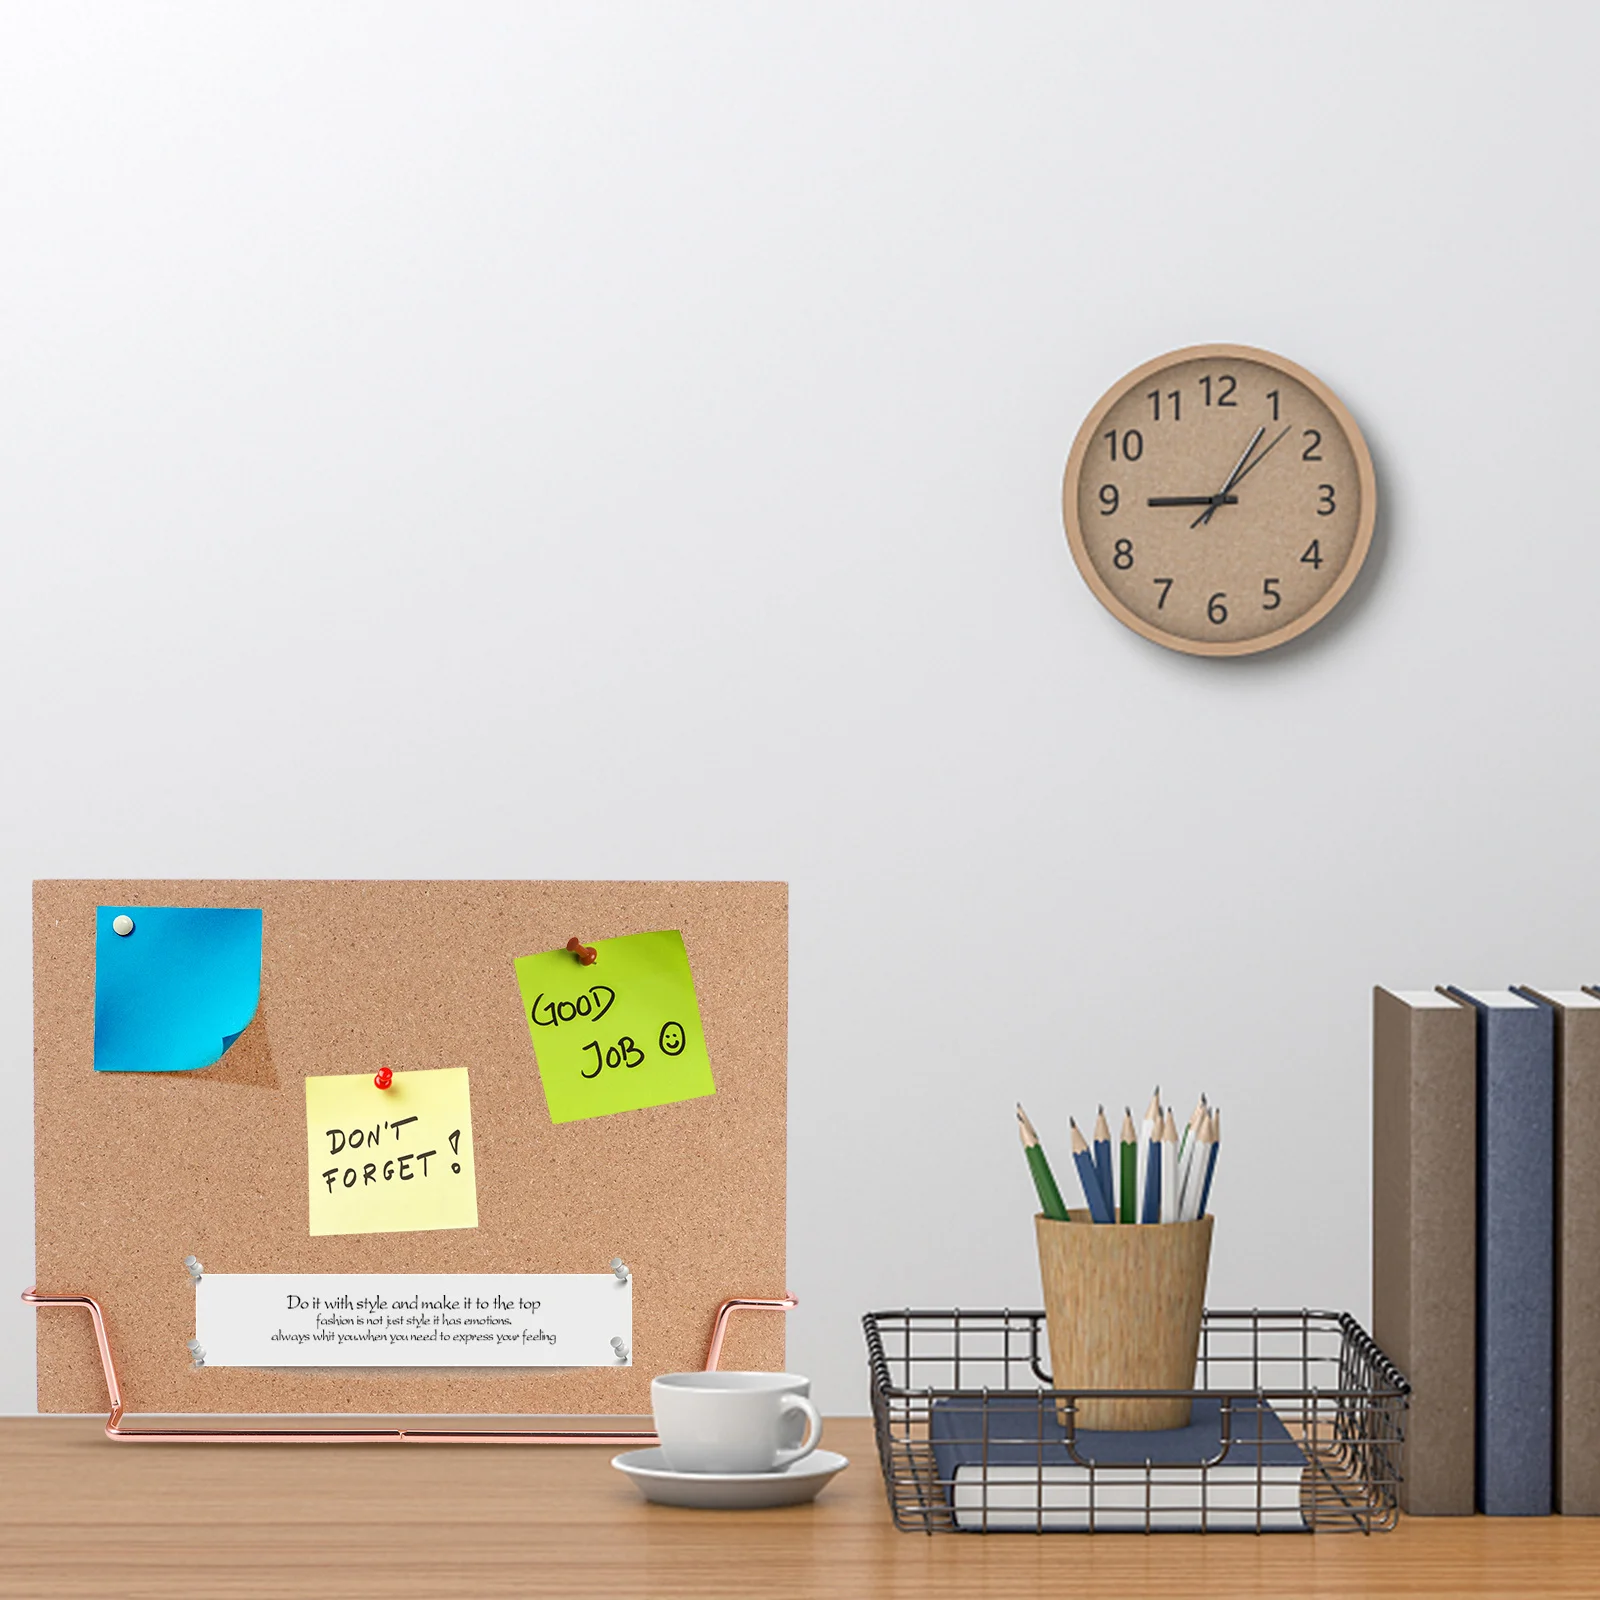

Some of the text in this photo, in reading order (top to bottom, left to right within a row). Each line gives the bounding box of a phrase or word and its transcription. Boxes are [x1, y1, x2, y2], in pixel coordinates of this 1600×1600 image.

[1147, 390, 1181, 421] 11
[1198, 375, 1238, 407] 12
[1266, 390, 1280, 421] 1
[1103, 429, 1144, 462] 10
[1302, 429, 1323, 461] 2
[1098, 484, 1120, 516] 9
[1316, 484, 1337, 516] 3
[1113, 538, 1135, 570] 8
[1300, 539, 1324, 570] 4
[1153, 578, 1174, 610] 7
[1207, 592, 1229, 625] 6
[1262, 578, 1282, 610] 5
[531, 985, 616, 1027] GOOD
[581, 1036, 645, 1079] JOB
[325, 1116, 419, 1155] DON'T
[286, 1294, 541, 1314] Do it with style and make it to the top
[316, 1312, 512, 1329] fashion is not just style it has emotions.
[270, 1328, 311, 1345] always
[312, 1328, 335, 1342] whit
[389, 1334, 409, 1345] you
[410, 1328, 438, 1342] need
[440, 1331, 451, 1341] to
[452, 1333, 494, 1345] express
[496, 1334, 520, 1345] your
[522, 1328, 557, 1346] feeling
